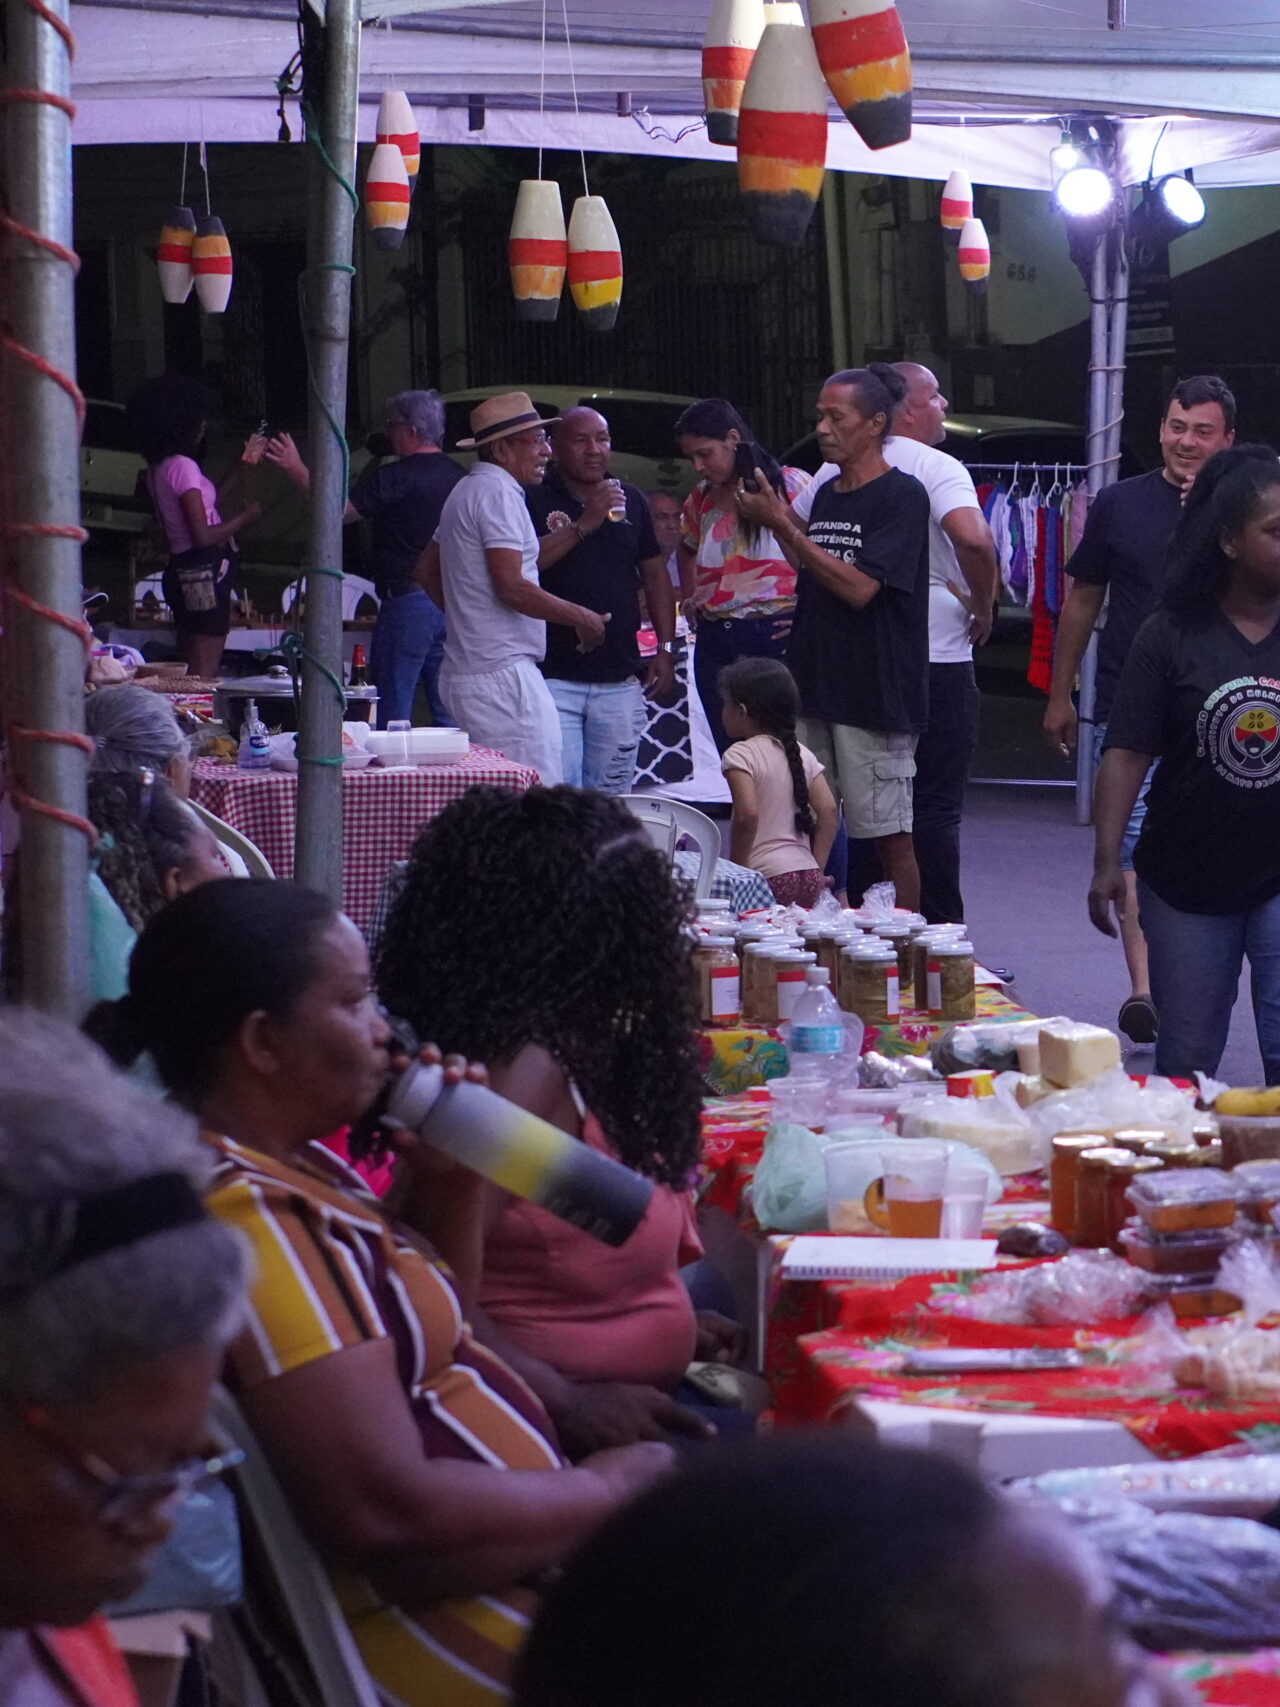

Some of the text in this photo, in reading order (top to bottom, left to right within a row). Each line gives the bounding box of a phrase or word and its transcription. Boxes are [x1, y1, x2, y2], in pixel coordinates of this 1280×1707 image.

[852, 524, 862, 534] A
[1203, 676, 1258, 710] CULTURAL
[1229, 692, 1244, 704] DE
[1225, 773, 1253, 789] MATO
